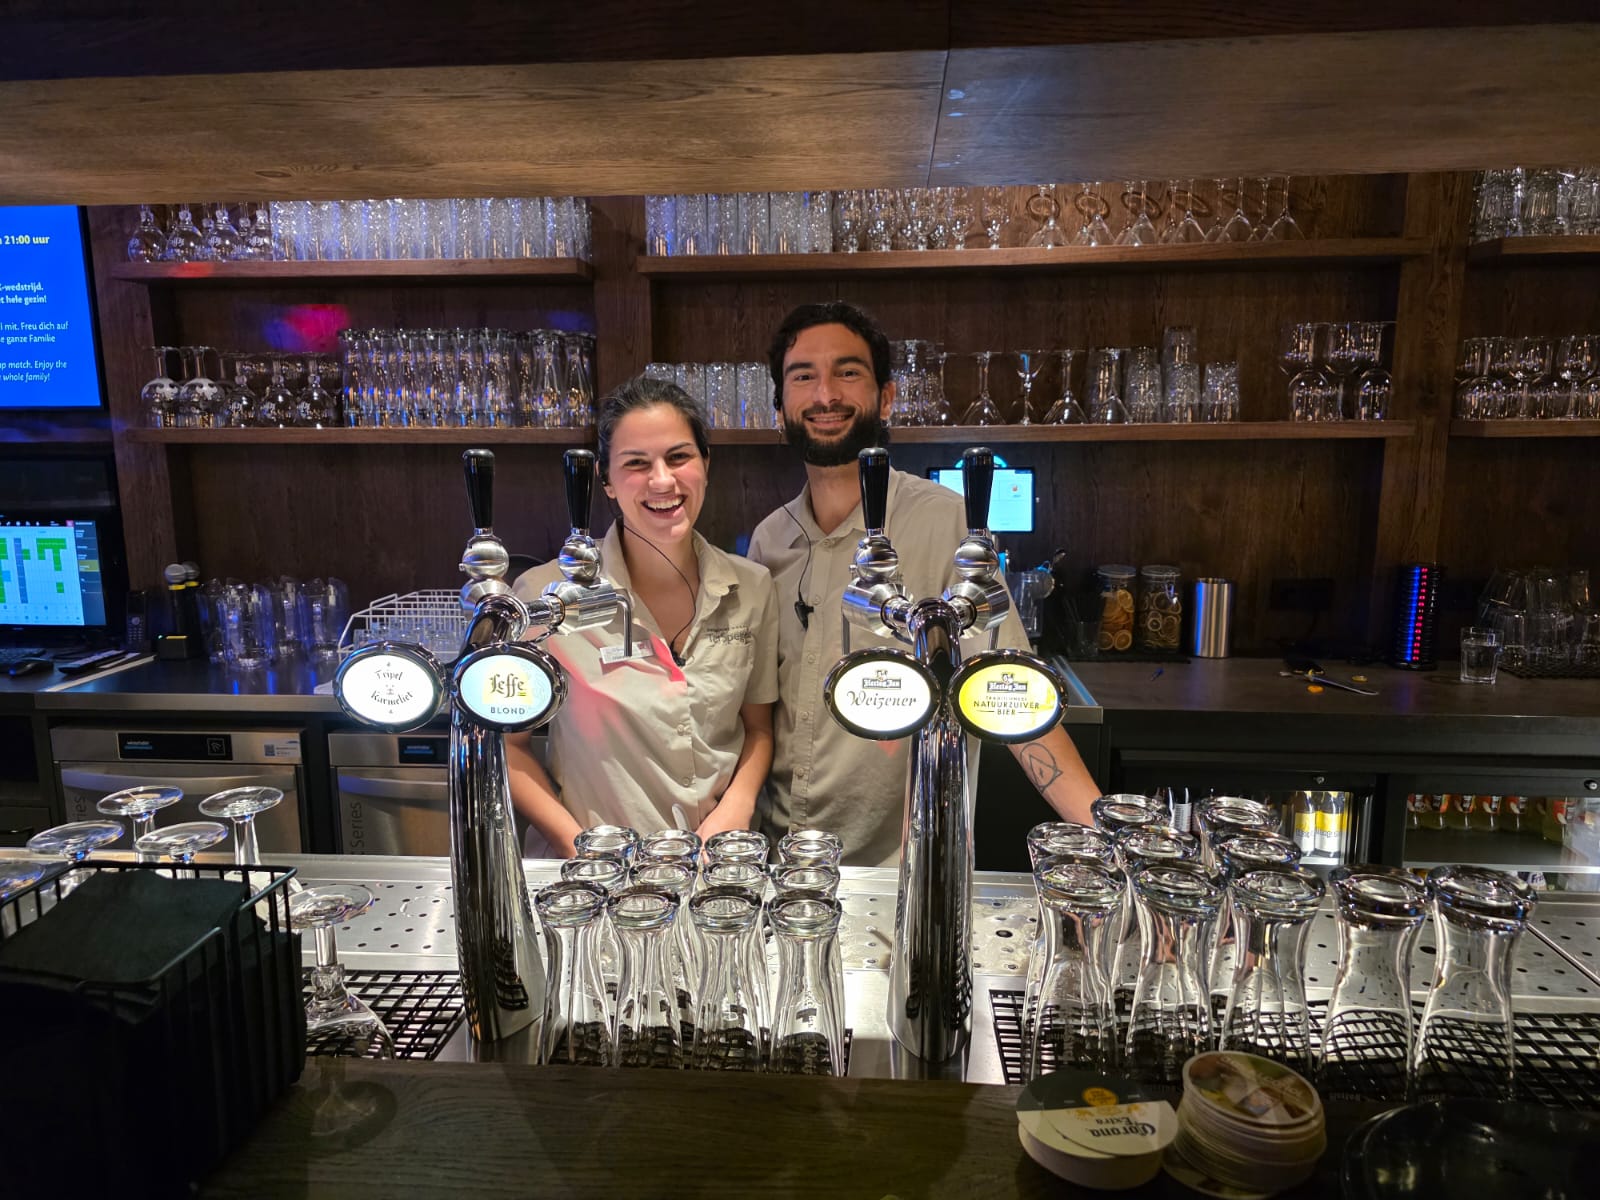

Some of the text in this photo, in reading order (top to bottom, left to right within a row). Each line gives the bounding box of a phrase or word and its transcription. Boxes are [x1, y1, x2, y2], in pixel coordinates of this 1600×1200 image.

[4, 234, 31, 245] 21:00
[32, 236, 50, 245] uur
[6, 294, 22, 304] hele
[24, 294, 47, 306] gezin!
[4, 322, 19, 331] mit.
[20, 322, 37, 330] Freu
[39, 321, 55, 330] dich
[56, 320, 70, 330] auf
[6, 336, 28, 345] ganze
[29, 333, 56, 343] Familie
[8, 359, 33, 369] match.
[34, 360, 54, 371] Enjoy
[55, 359, 67, 369] the
[3, 372, 24, 382] whole
[25, 372, 51, 383] family!
[374, 669, 403, 681] Tripel
[489, 673, 526, 699] Leffe
[370, 690, 413, 705] Karmeliet
[846, 690, 918, 710] Weizener
[490, 706, 526, 715] BLOND
[973, 701, 1040, 710] NATUURZUIVER
[997, 708, 1016, 716] BIER
[349, 802, 365, 848] Series
[1095, 1116, 1132, 1126] Extra
[1088, 1122, 1156, 1139] Corona
